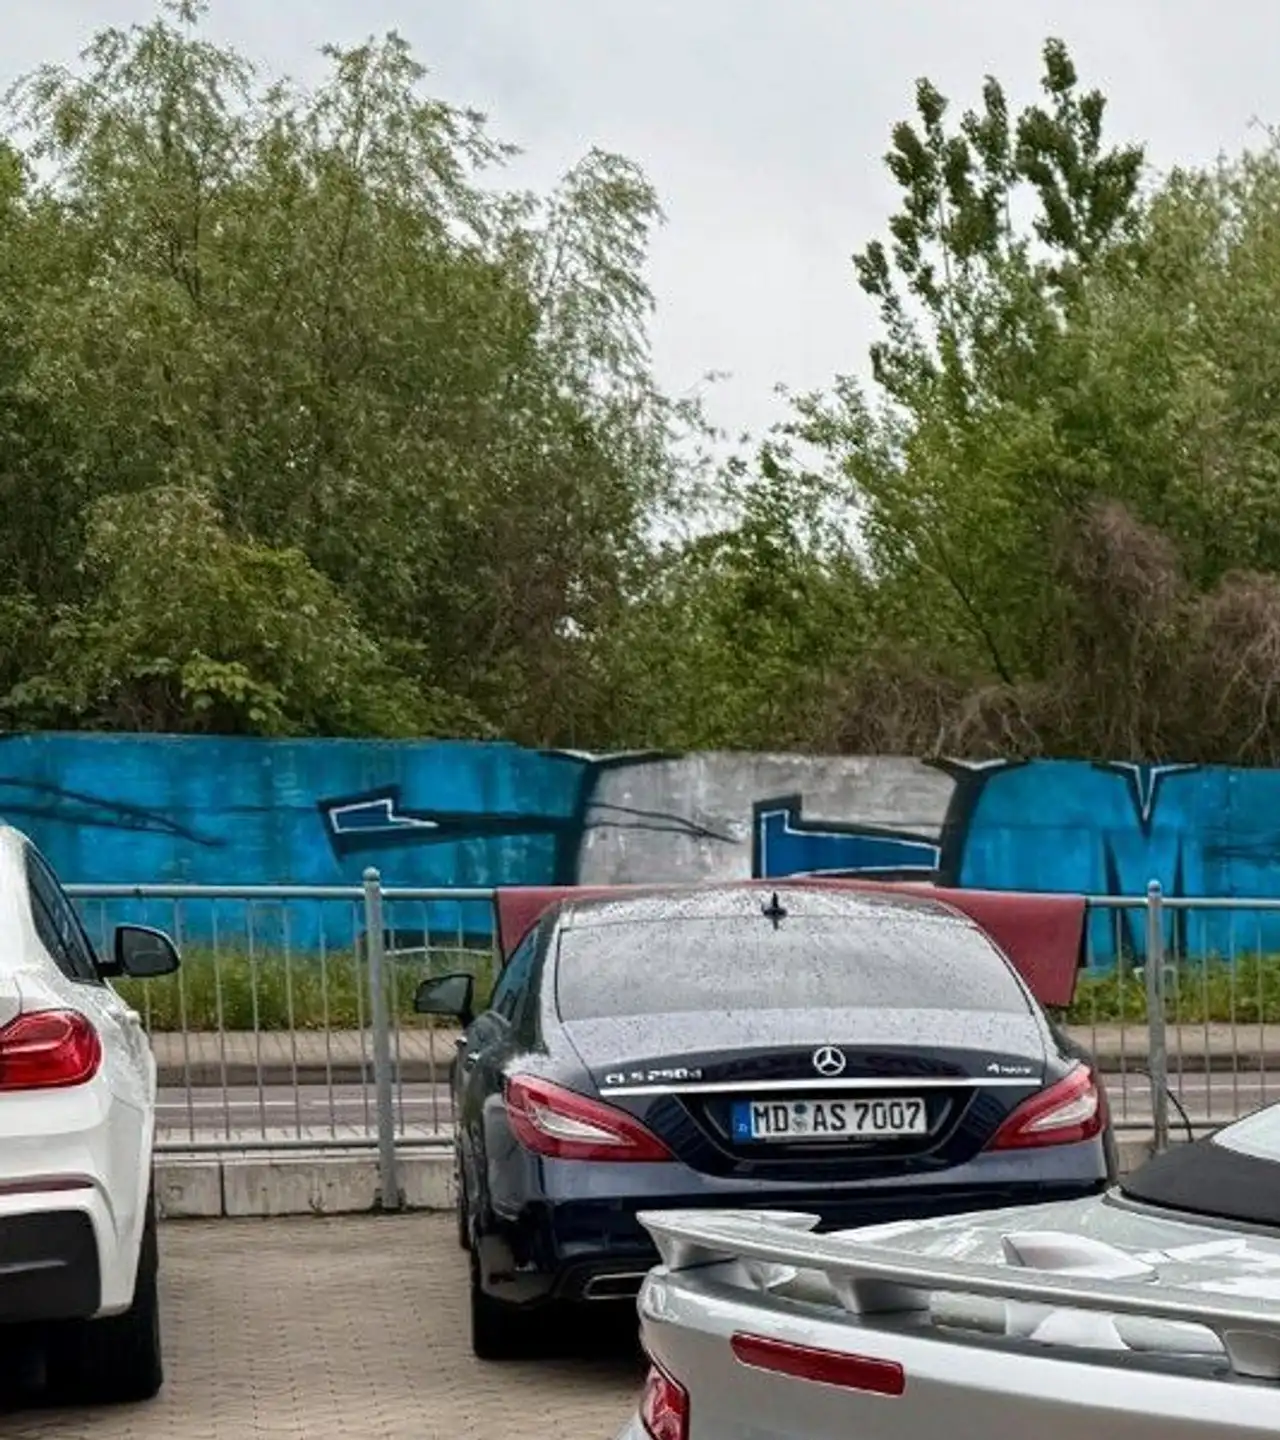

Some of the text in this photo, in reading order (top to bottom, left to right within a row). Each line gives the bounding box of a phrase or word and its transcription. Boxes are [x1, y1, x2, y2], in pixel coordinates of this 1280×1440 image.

[753, 1101, 922, 1133] MD AS 7007
